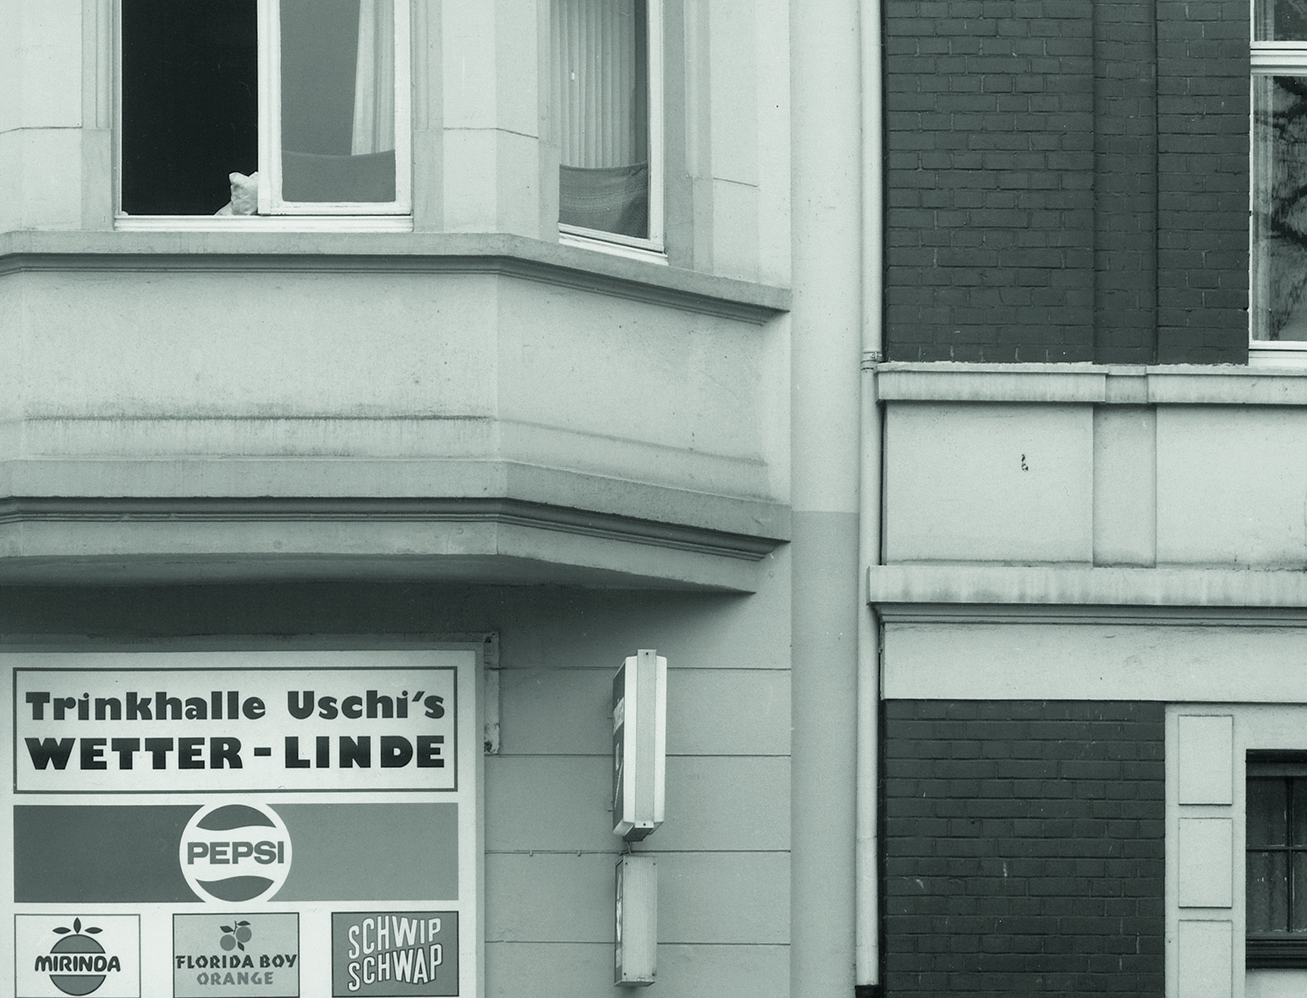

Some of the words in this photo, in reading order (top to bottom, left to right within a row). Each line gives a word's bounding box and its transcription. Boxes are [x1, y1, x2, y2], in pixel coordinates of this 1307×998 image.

[26, 691, 265, 721] Trinkhalle
[287, 690, 445, 719] Uschi's
[187, 841, 284, 864] PEPSI
[348, 916, 441, 959] SCHWIP
[35, 955, 121, 973] MIRINDA
[176, 955, 253, 969] FLORIDA
[260, 954, 297, 968] BOY
[348, 944, 442, 992] SCHWAP
[197, 971, 273, 985] ORANGE
